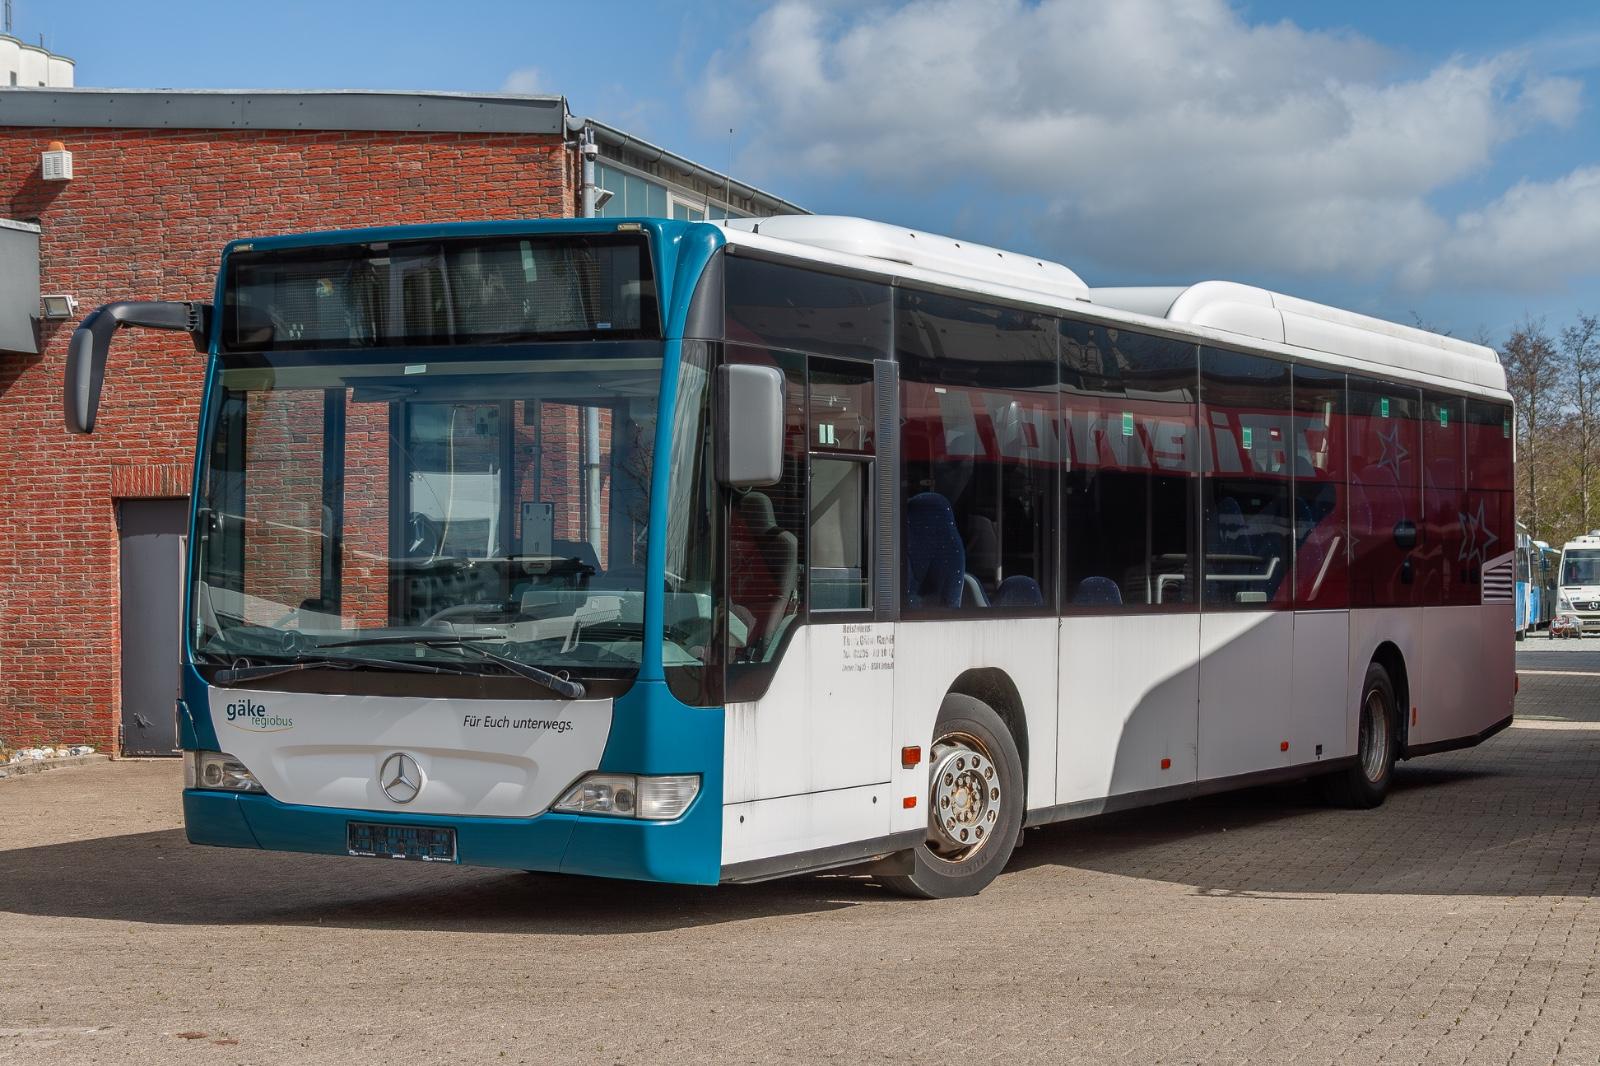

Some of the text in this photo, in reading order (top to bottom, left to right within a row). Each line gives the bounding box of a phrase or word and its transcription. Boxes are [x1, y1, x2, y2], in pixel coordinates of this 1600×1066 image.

[226, 699, 266, 721] gäke
[251, 714, 294, 729] regiobus
[463, 715, 574, 734] Für Euch unterwegs.
